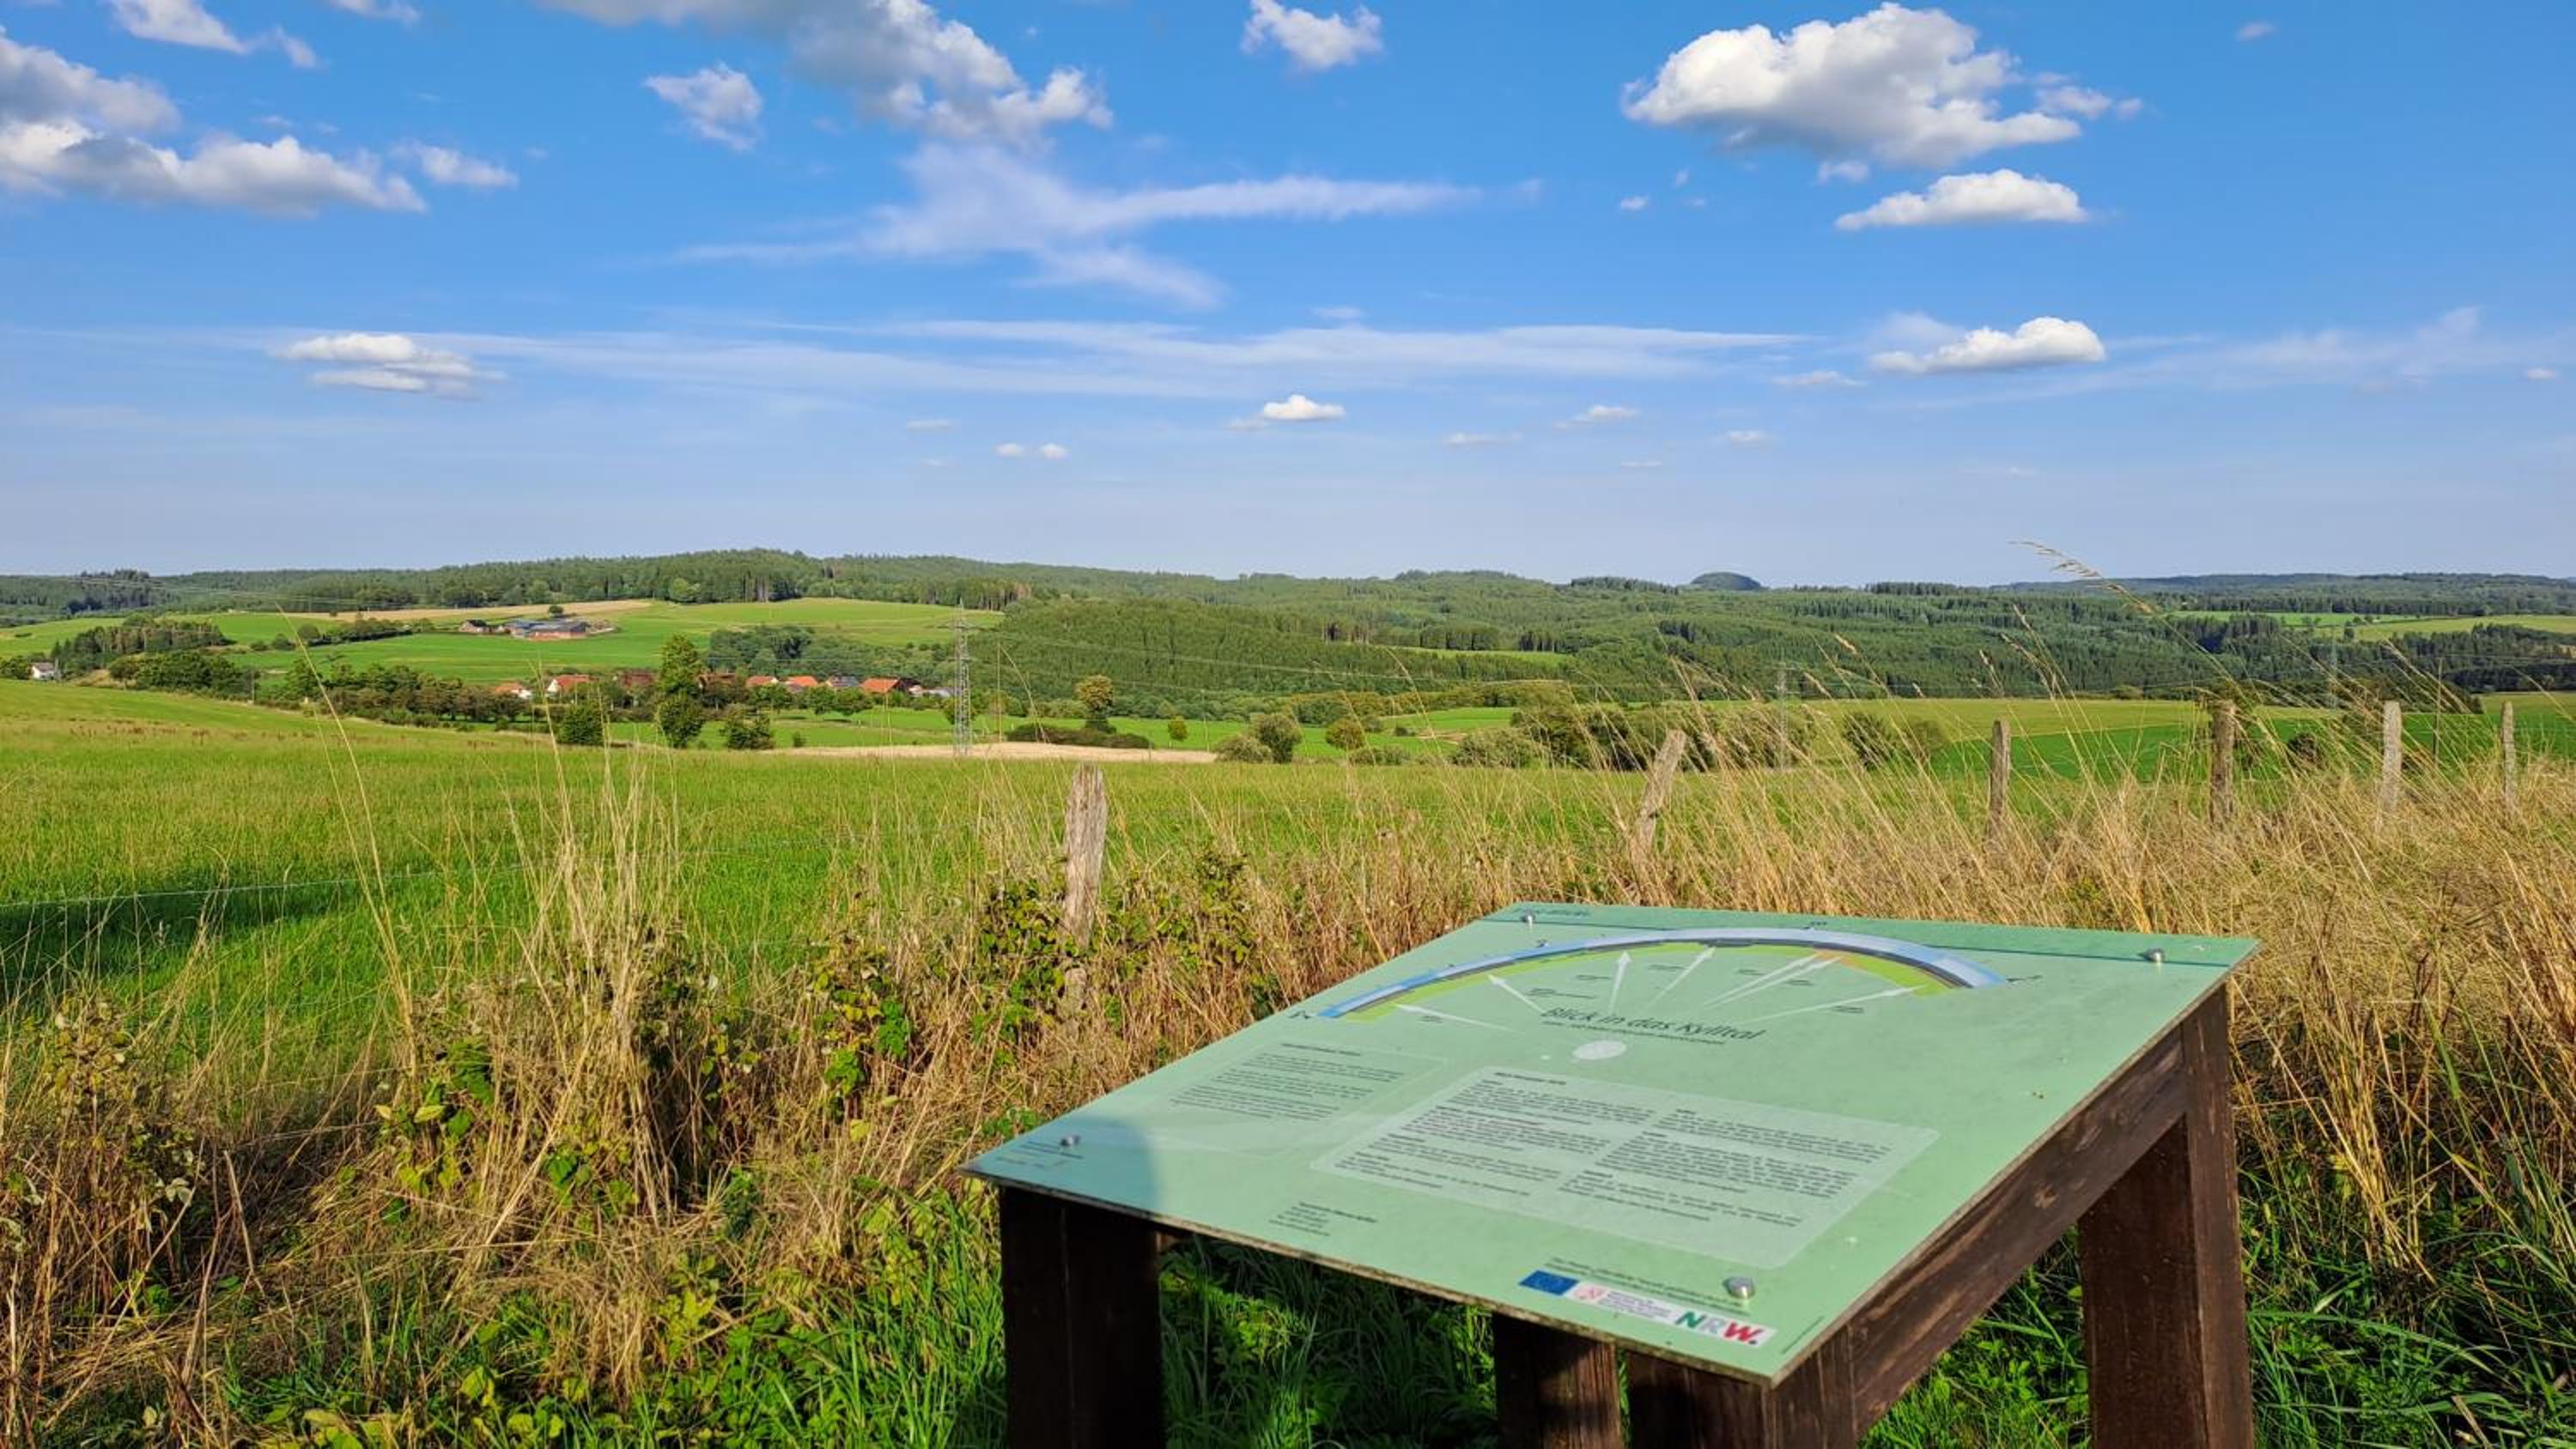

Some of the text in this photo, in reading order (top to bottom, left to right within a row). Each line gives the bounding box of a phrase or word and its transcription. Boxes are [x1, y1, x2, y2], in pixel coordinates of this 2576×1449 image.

[1540, 1007, 1598, 1022] Blick
[1597, 1013, 1625, 1024] in
[1626, 1016, 1676, 1030] das
[1675, 1022, 1767, 1040] Kylltal
